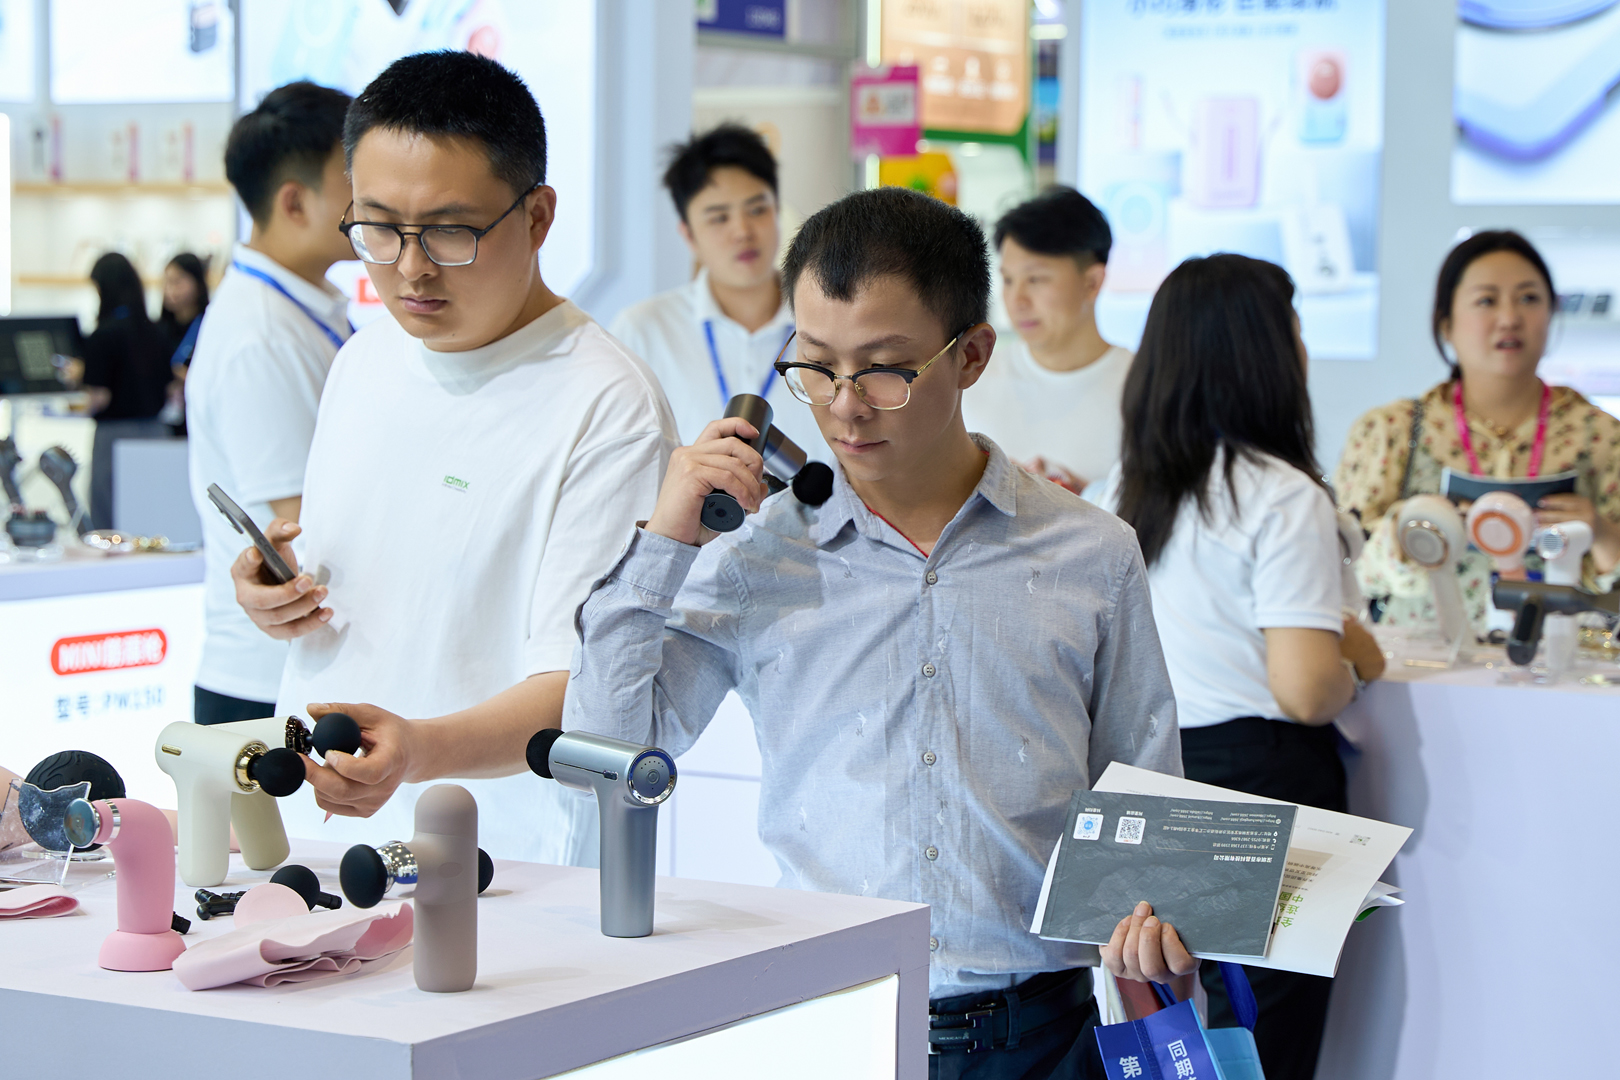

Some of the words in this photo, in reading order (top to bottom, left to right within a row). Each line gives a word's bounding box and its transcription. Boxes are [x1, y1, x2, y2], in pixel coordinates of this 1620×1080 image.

[1279, 891, 1304, 903] 中国
[1119, 1055, 1143, 1080] 第
[1167, 1039, 1197, 1080] 同期
